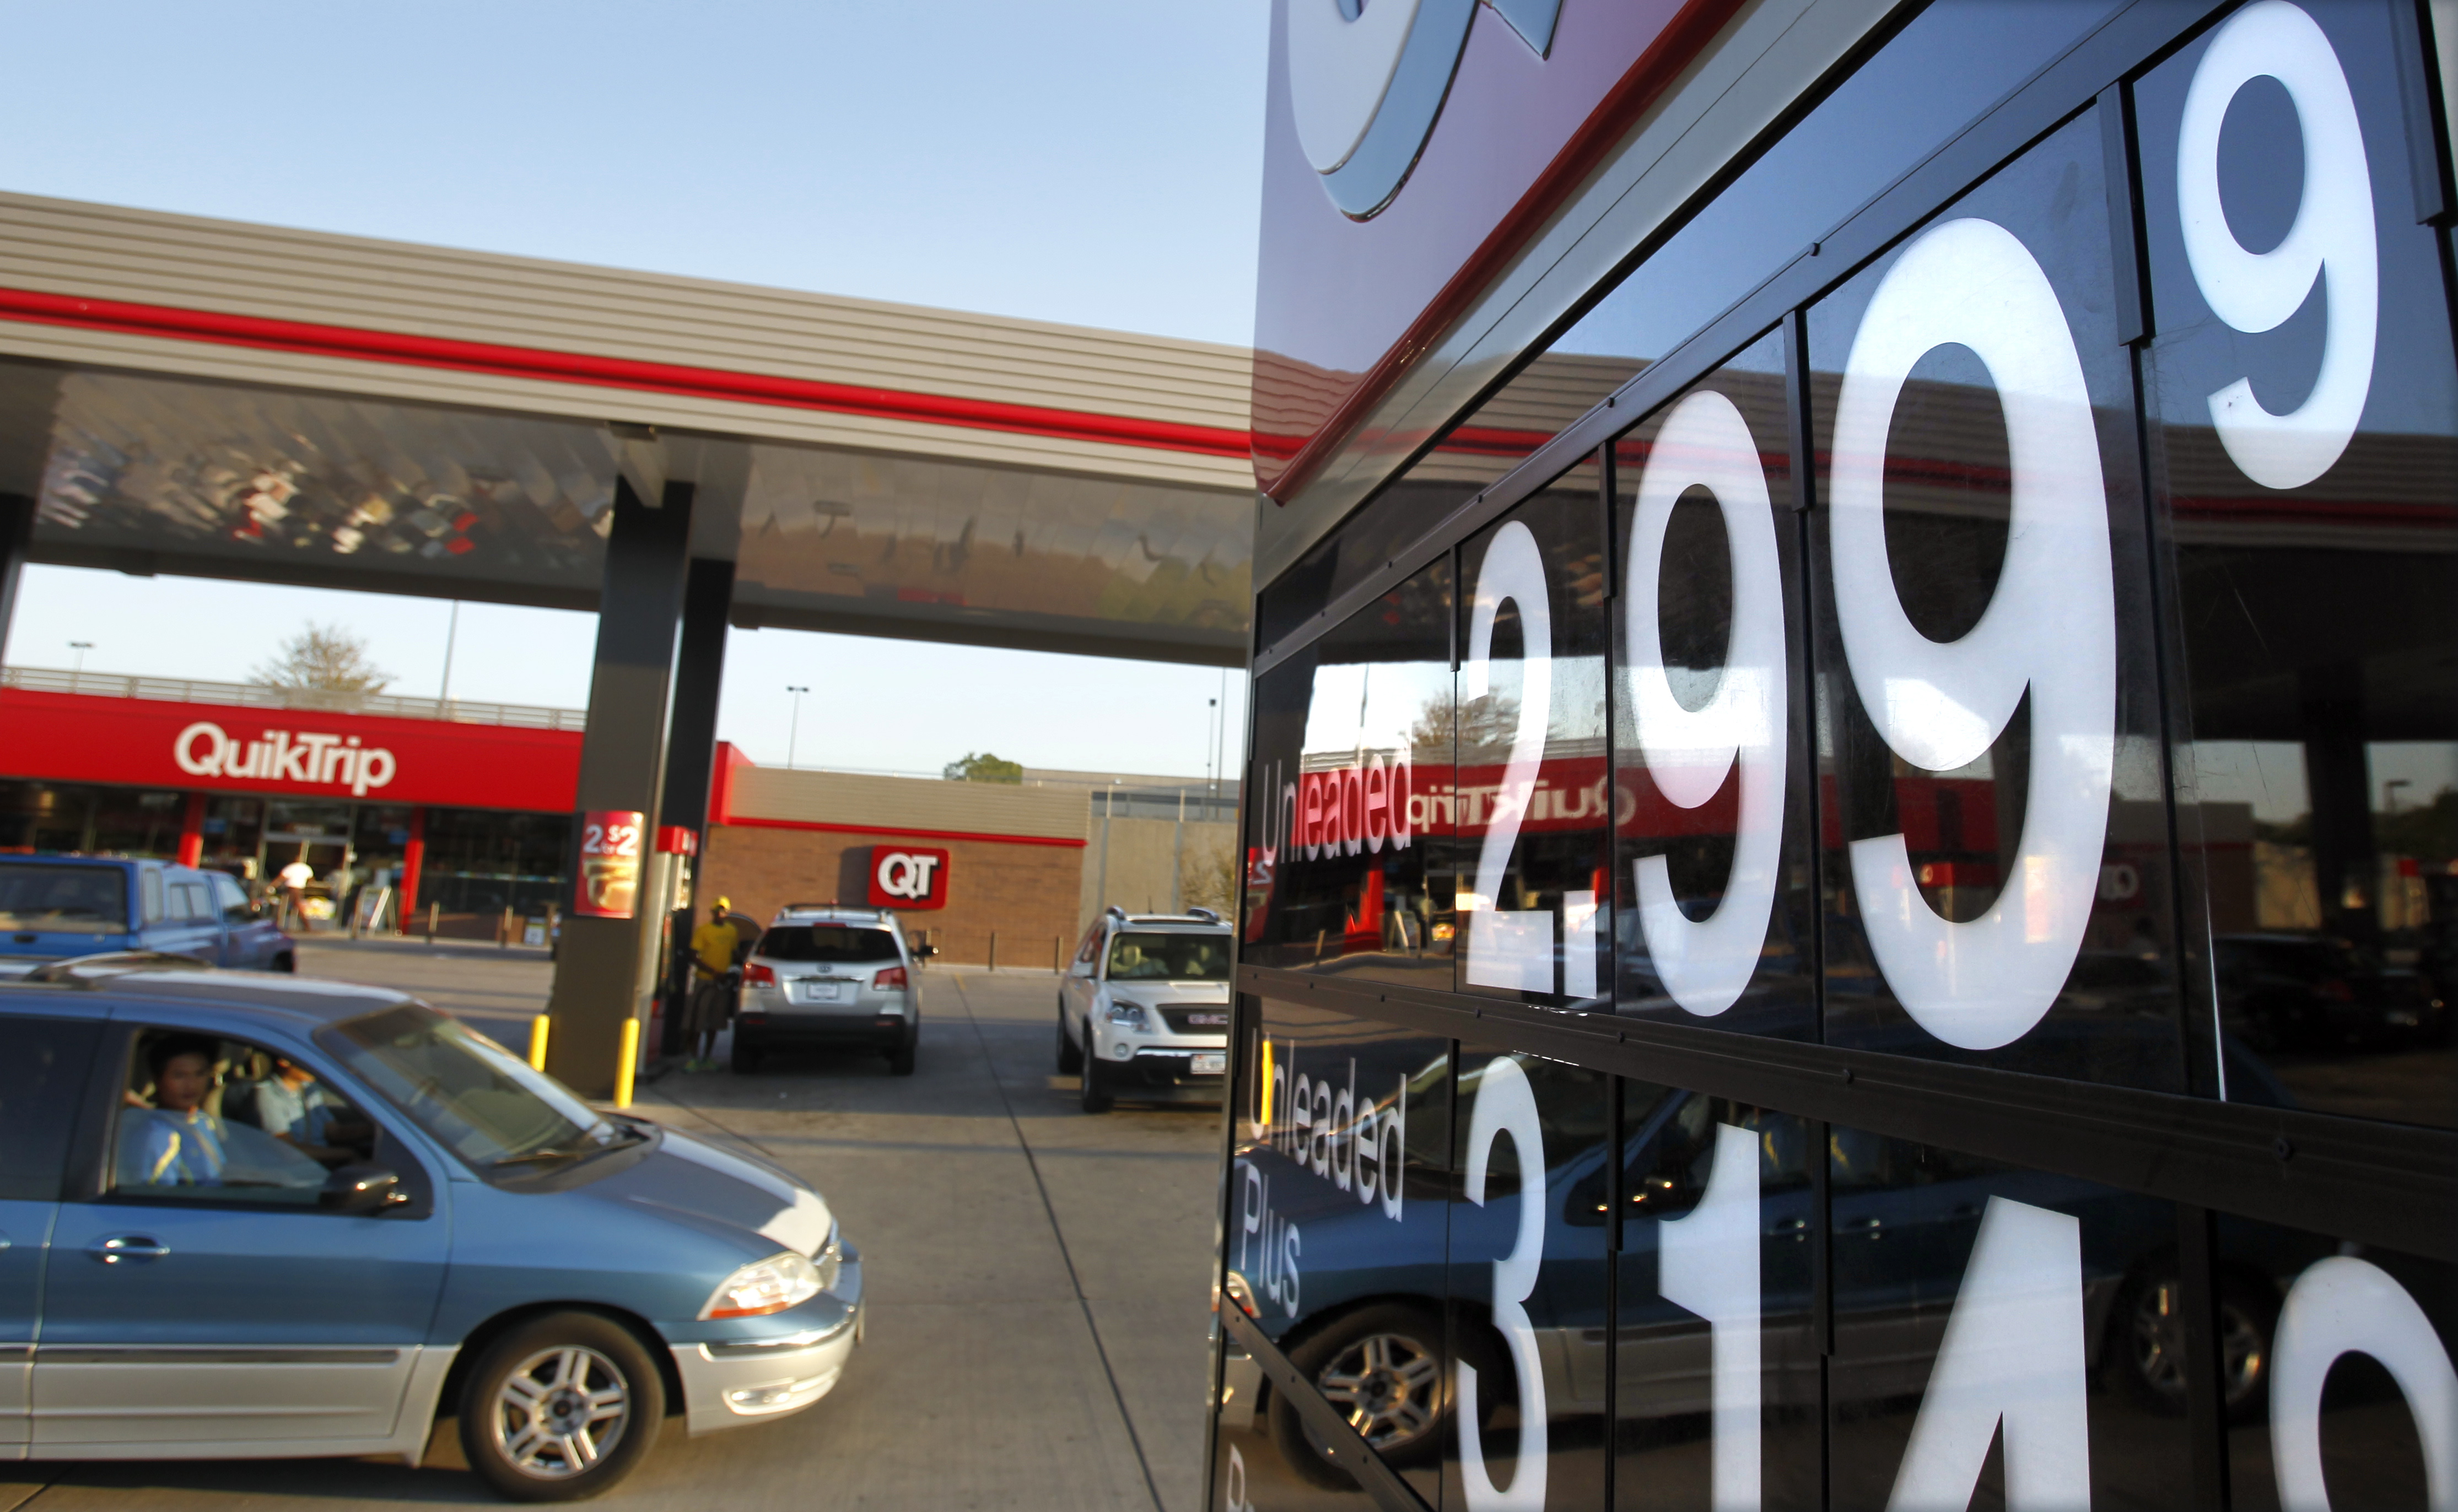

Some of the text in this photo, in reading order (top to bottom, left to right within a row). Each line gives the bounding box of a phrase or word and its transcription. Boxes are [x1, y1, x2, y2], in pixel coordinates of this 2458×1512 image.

[174, 721, 396, 796] QuikTrip
[1262, 721, 1412, 867] Unleaded
[584, 824, 603, 853] 2
[878, 853, 938, 899] QT
[1248, 1028, 1407, 1223] Unleaded
[1240, 1163, 1301, 1319] Plus
